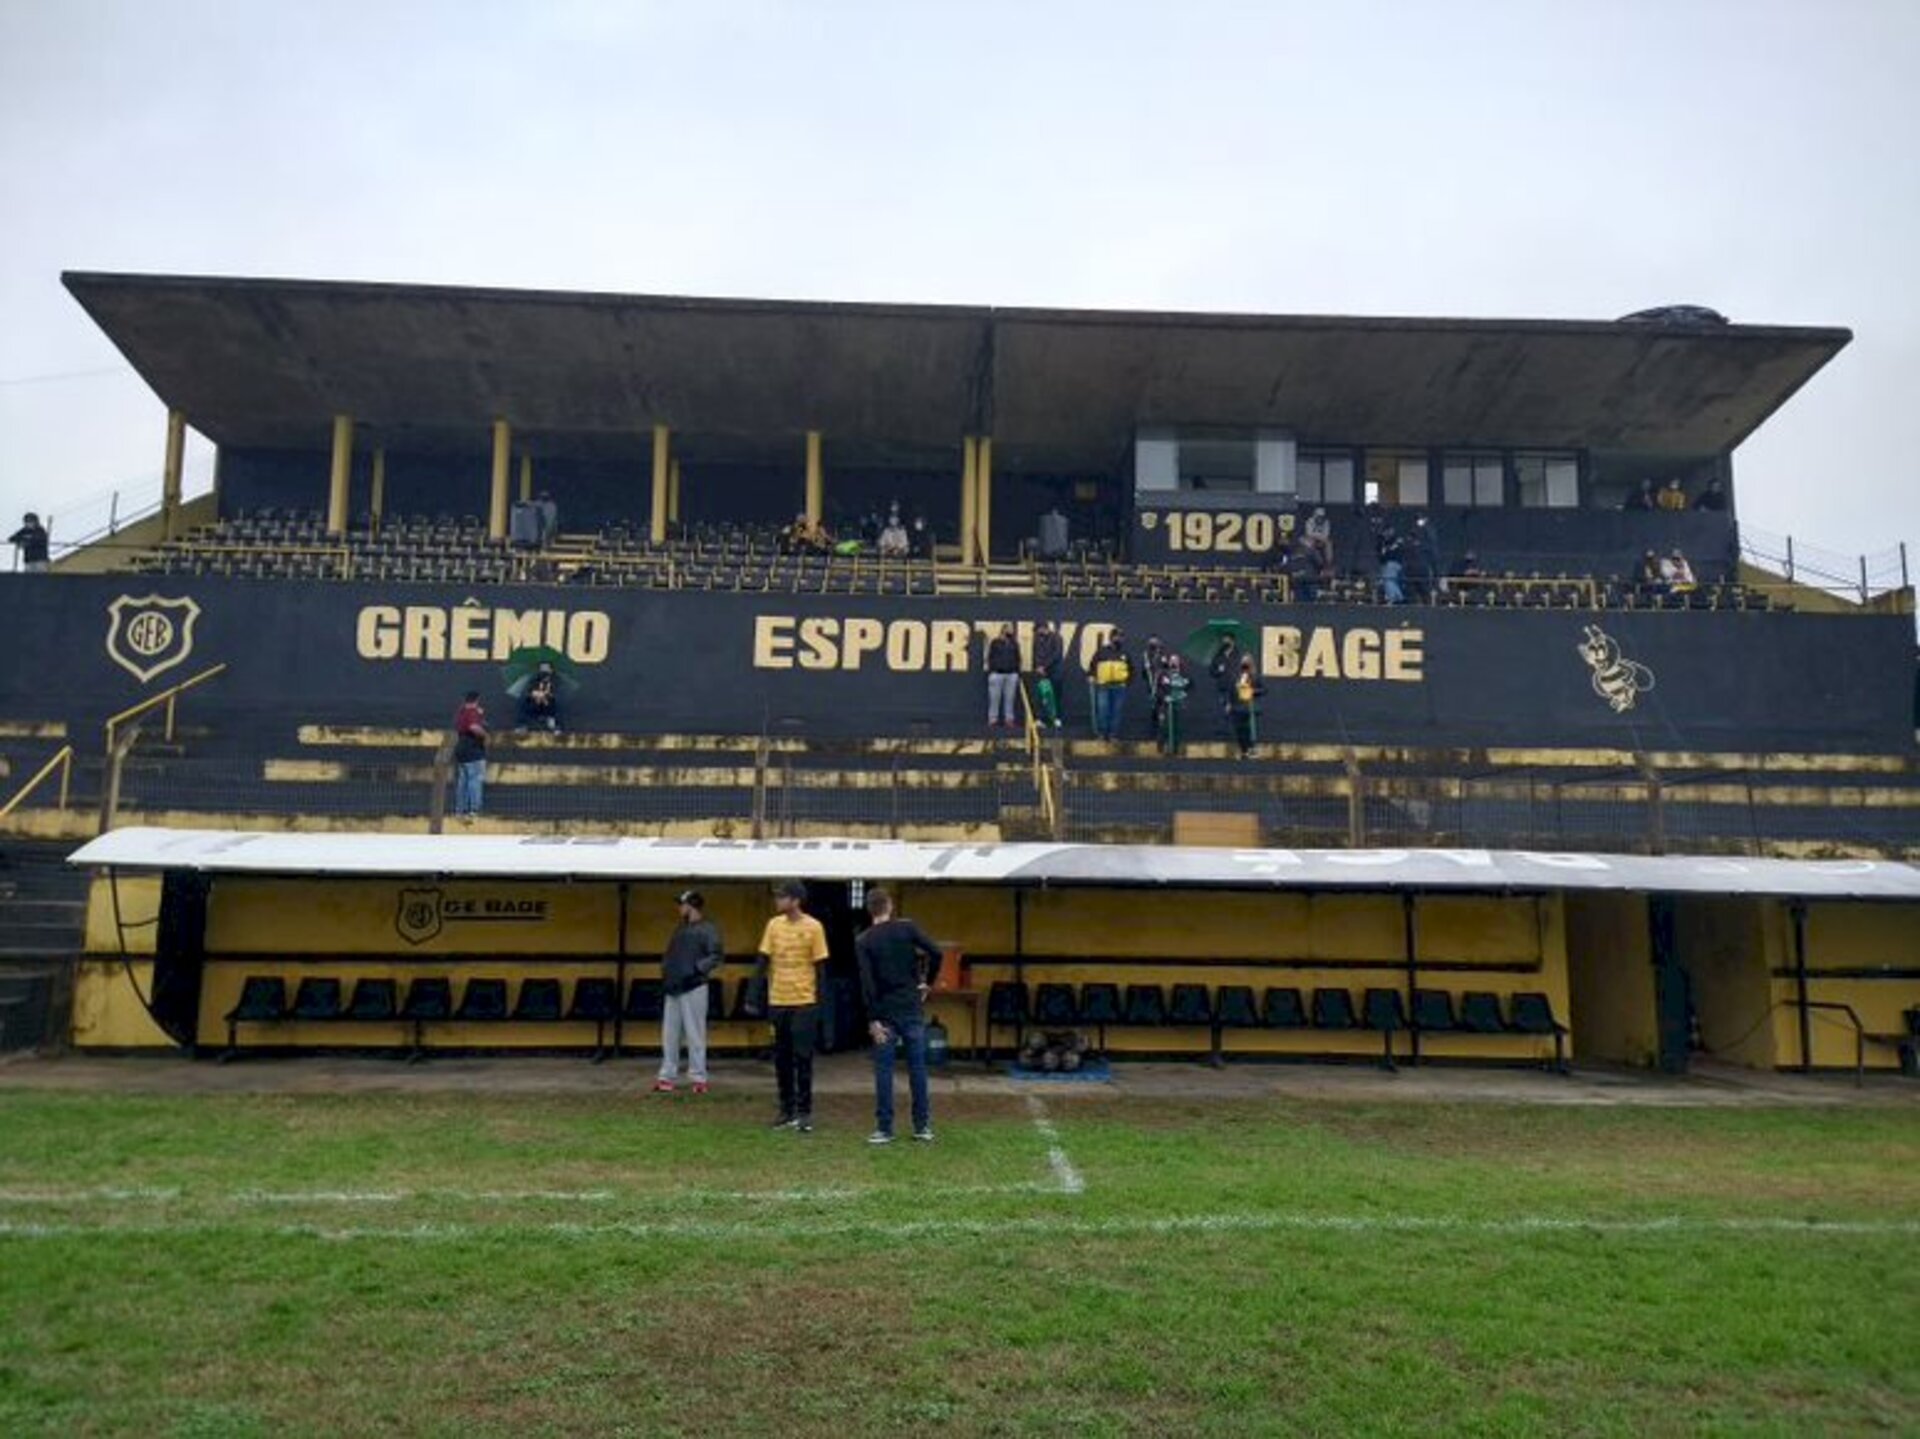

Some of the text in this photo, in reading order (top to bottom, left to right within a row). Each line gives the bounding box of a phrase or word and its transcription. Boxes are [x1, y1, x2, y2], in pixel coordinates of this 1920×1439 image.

[1165, 512, 1273, 552] 1920
[356, 597, 610, 663] GRÊMIO
[1261, 620, 1424, 681] BAGÉ
